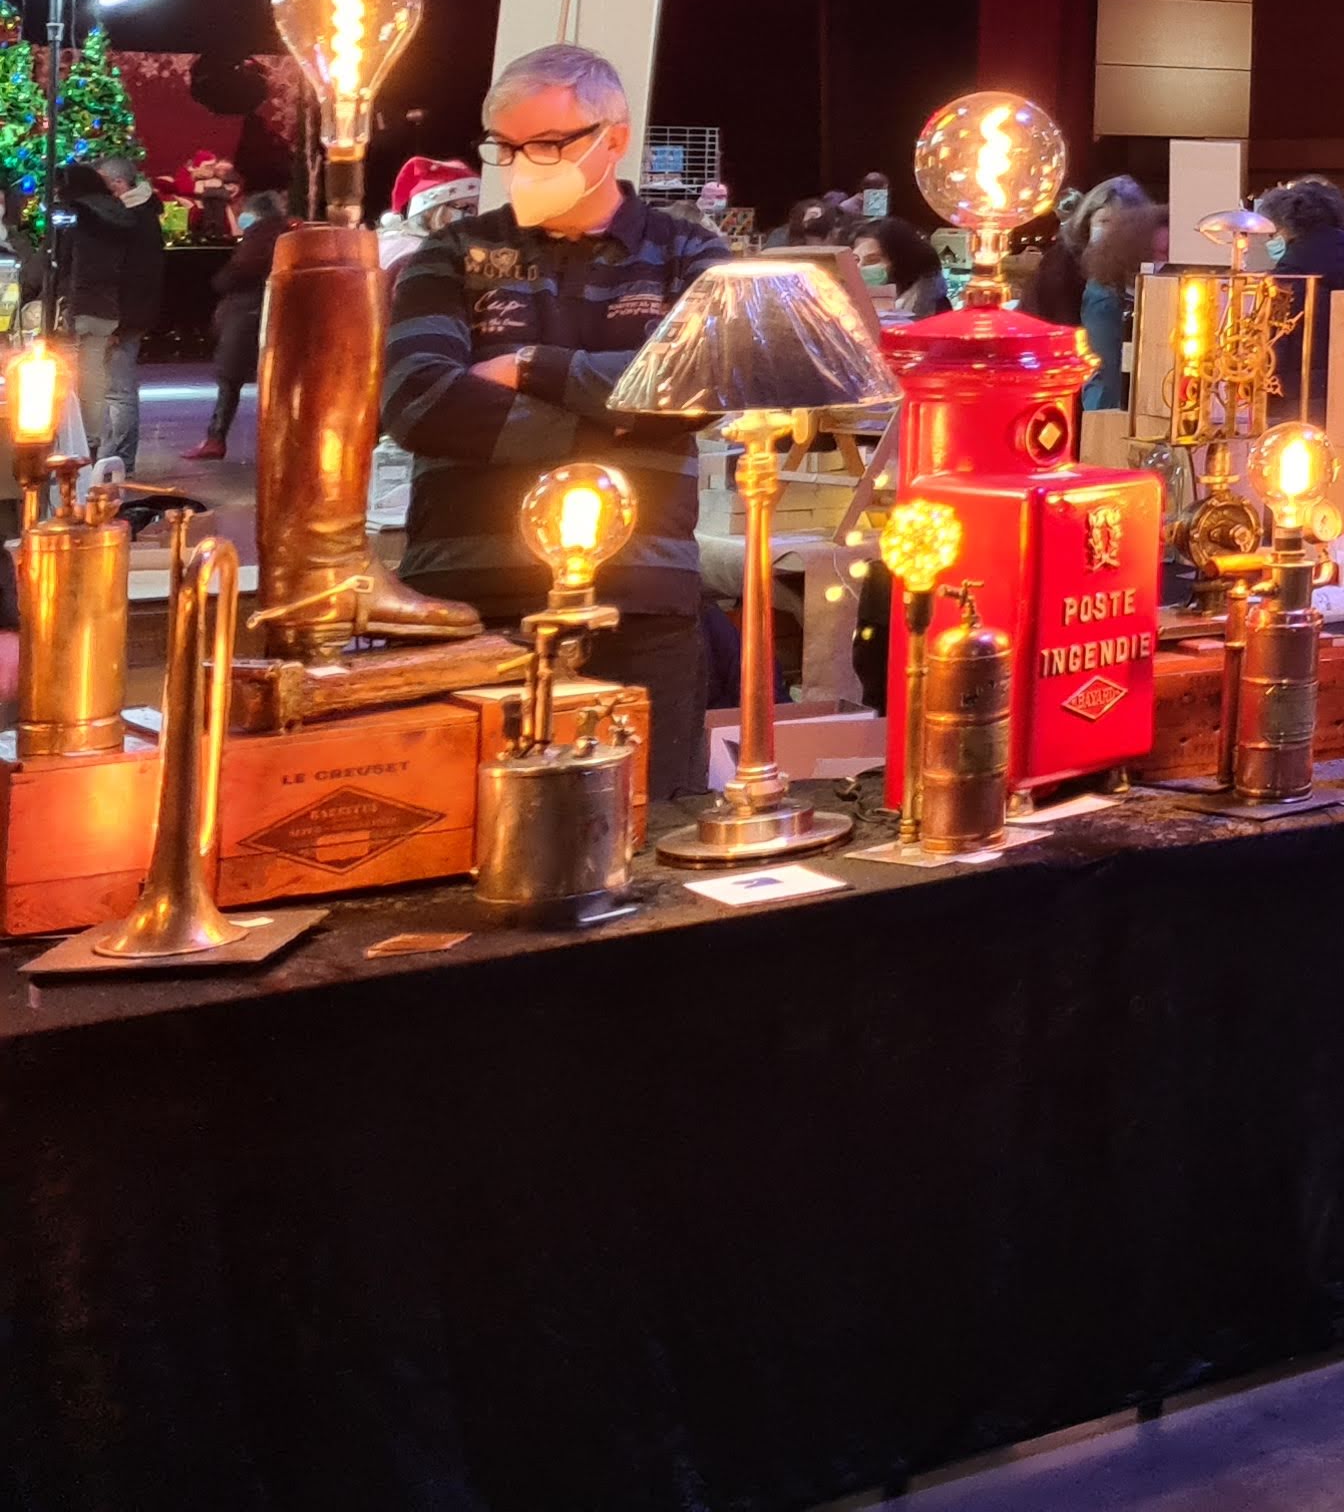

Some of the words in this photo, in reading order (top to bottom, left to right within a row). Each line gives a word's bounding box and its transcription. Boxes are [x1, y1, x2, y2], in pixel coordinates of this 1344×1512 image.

[1063, 588, 1137, 626] POSTE
[282, 773, 306, 785] LE
[314, 761, 411, 782] CREUSET
